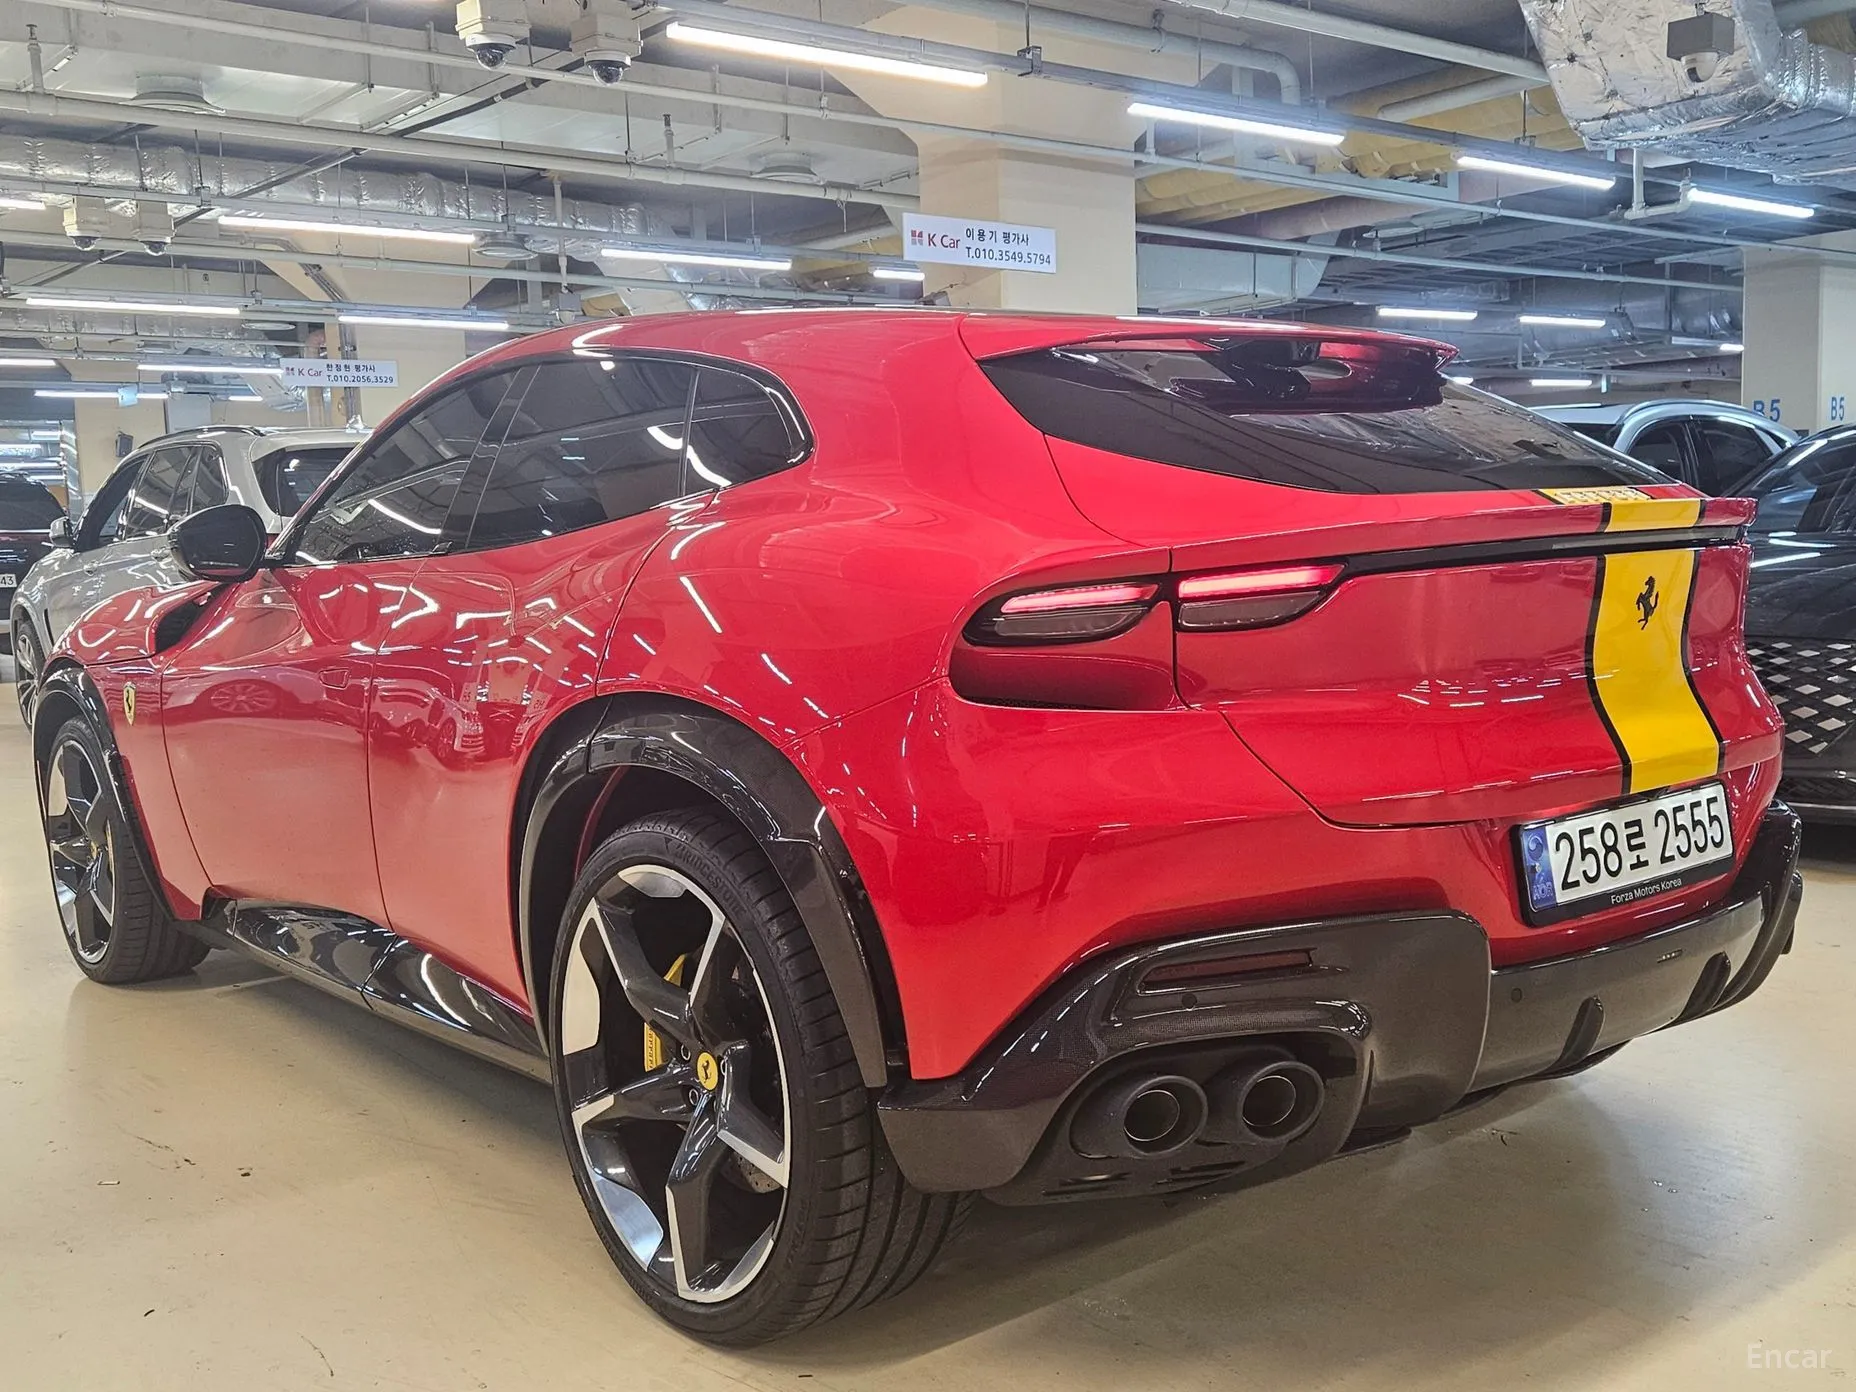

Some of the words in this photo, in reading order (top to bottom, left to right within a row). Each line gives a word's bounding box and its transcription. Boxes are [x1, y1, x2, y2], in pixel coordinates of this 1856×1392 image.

[928, 233, 937, 247] K
[940, 234, 961, 249] Car
[1002, 231, 1030, 246] 평가사
[965, 246, 1051, 266] T.010.3549.5794
[298, 368, 305, 377] K
[307, 368, 323, 377] Car
[354, 364, 376, 373] 평가사
[1830, 396, 1845, 421] B5
[1654, 796, 1724, 865] 2555
[1611, 891, 1634, 905] Forza
[1634, 884, 1661, 898] Motors
[1661, 878, 1683, 891] Korea
